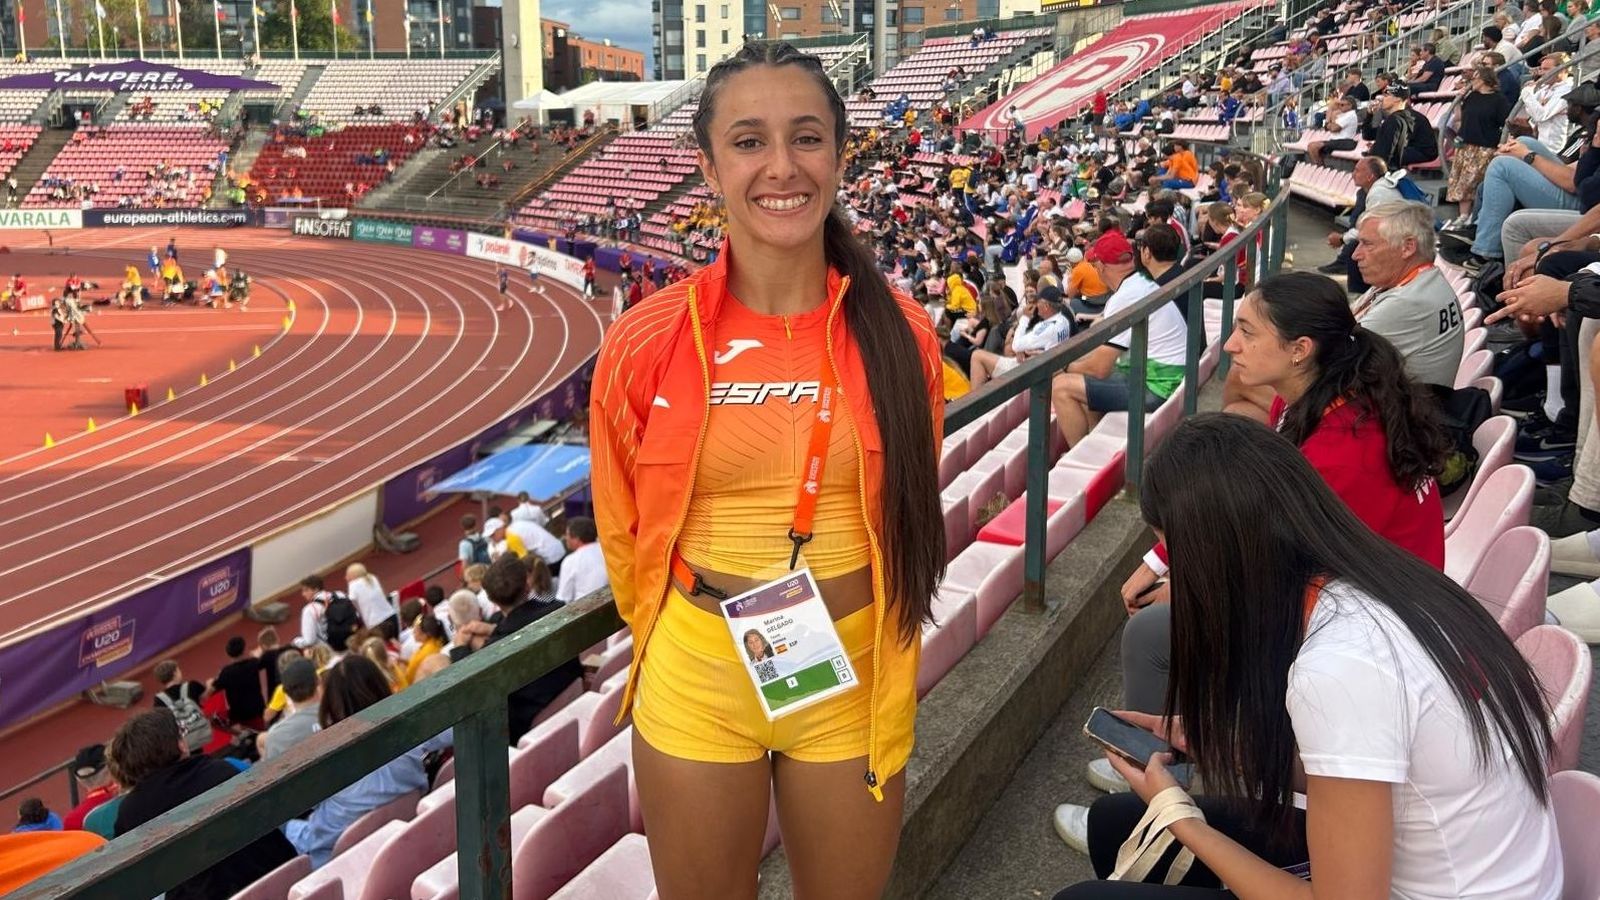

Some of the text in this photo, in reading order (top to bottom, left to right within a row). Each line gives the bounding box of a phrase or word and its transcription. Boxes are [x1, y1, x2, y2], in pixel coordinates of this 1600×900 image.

[119, 82, 194, 91] FINLAND
[0, 211, 71, 226] VARALA
[209, 579, 230, 597] U20
[763, 615, 784, 626] Marina
[766, 618, 794, 633] DELGADO
[94, 630, 120, 648] U20
